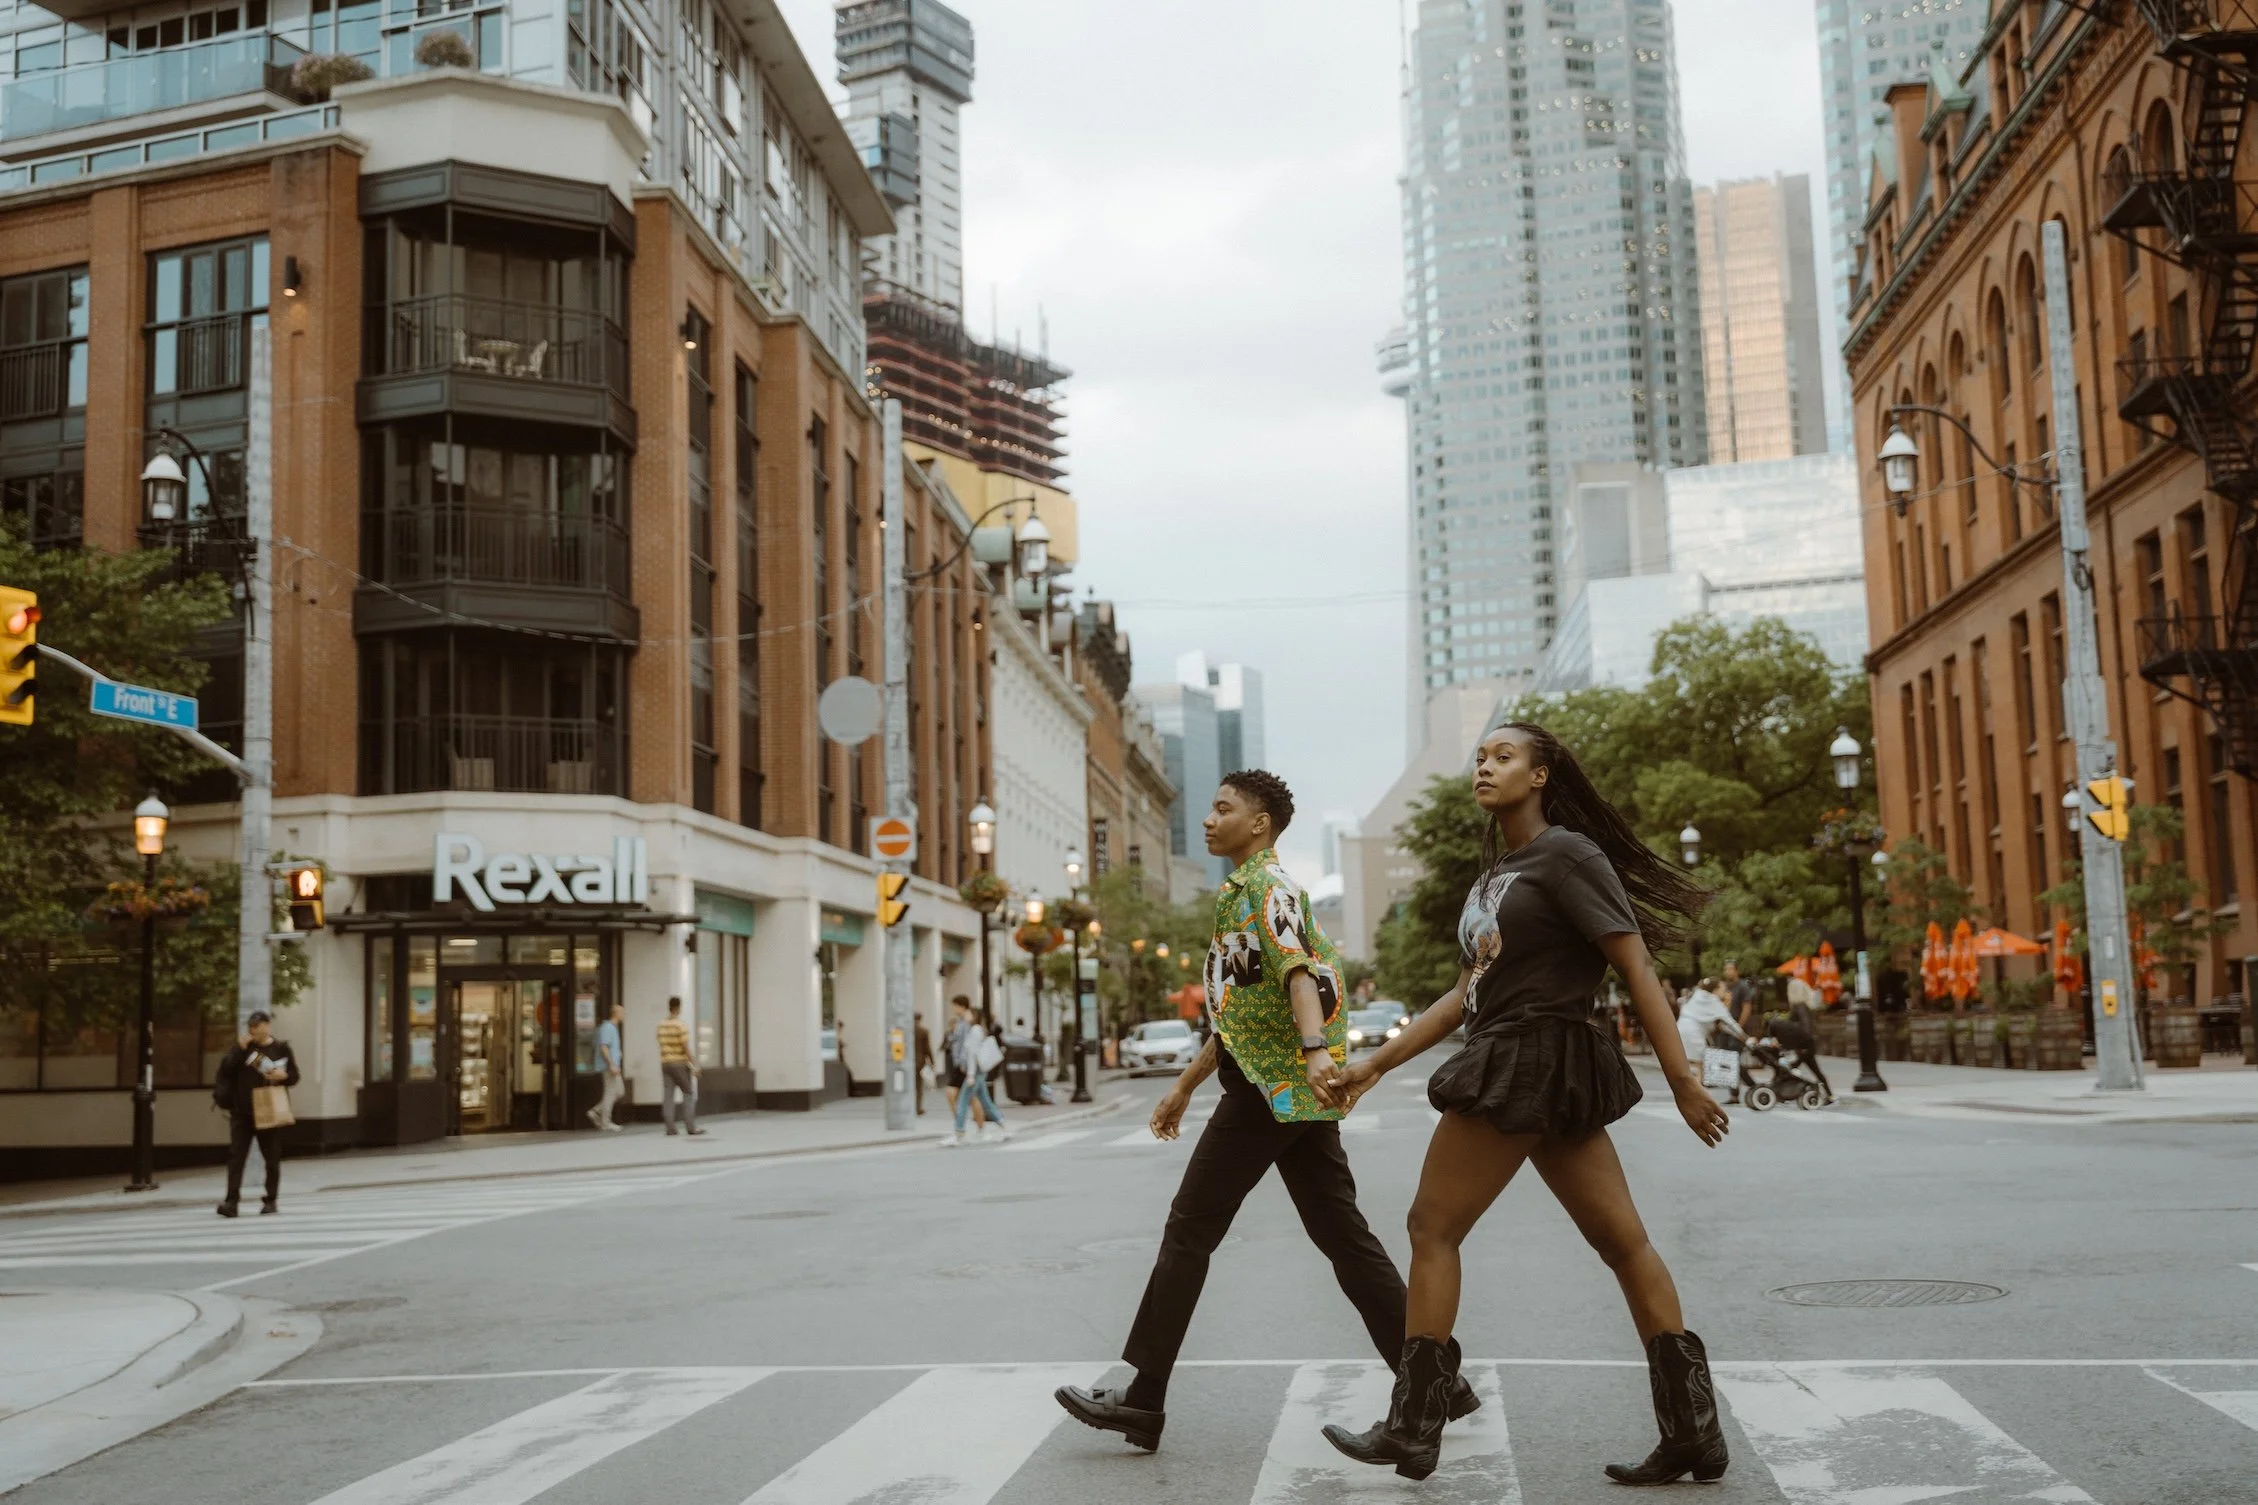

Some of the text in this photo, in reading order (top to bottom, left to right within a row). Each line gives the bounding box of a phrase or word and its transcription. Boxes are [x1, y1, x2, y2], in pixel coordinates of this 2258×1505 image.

[114, 686, 156, 716] Front
[167, 696, 178, 720] E
[434, 832, 647, 912] Rexall
